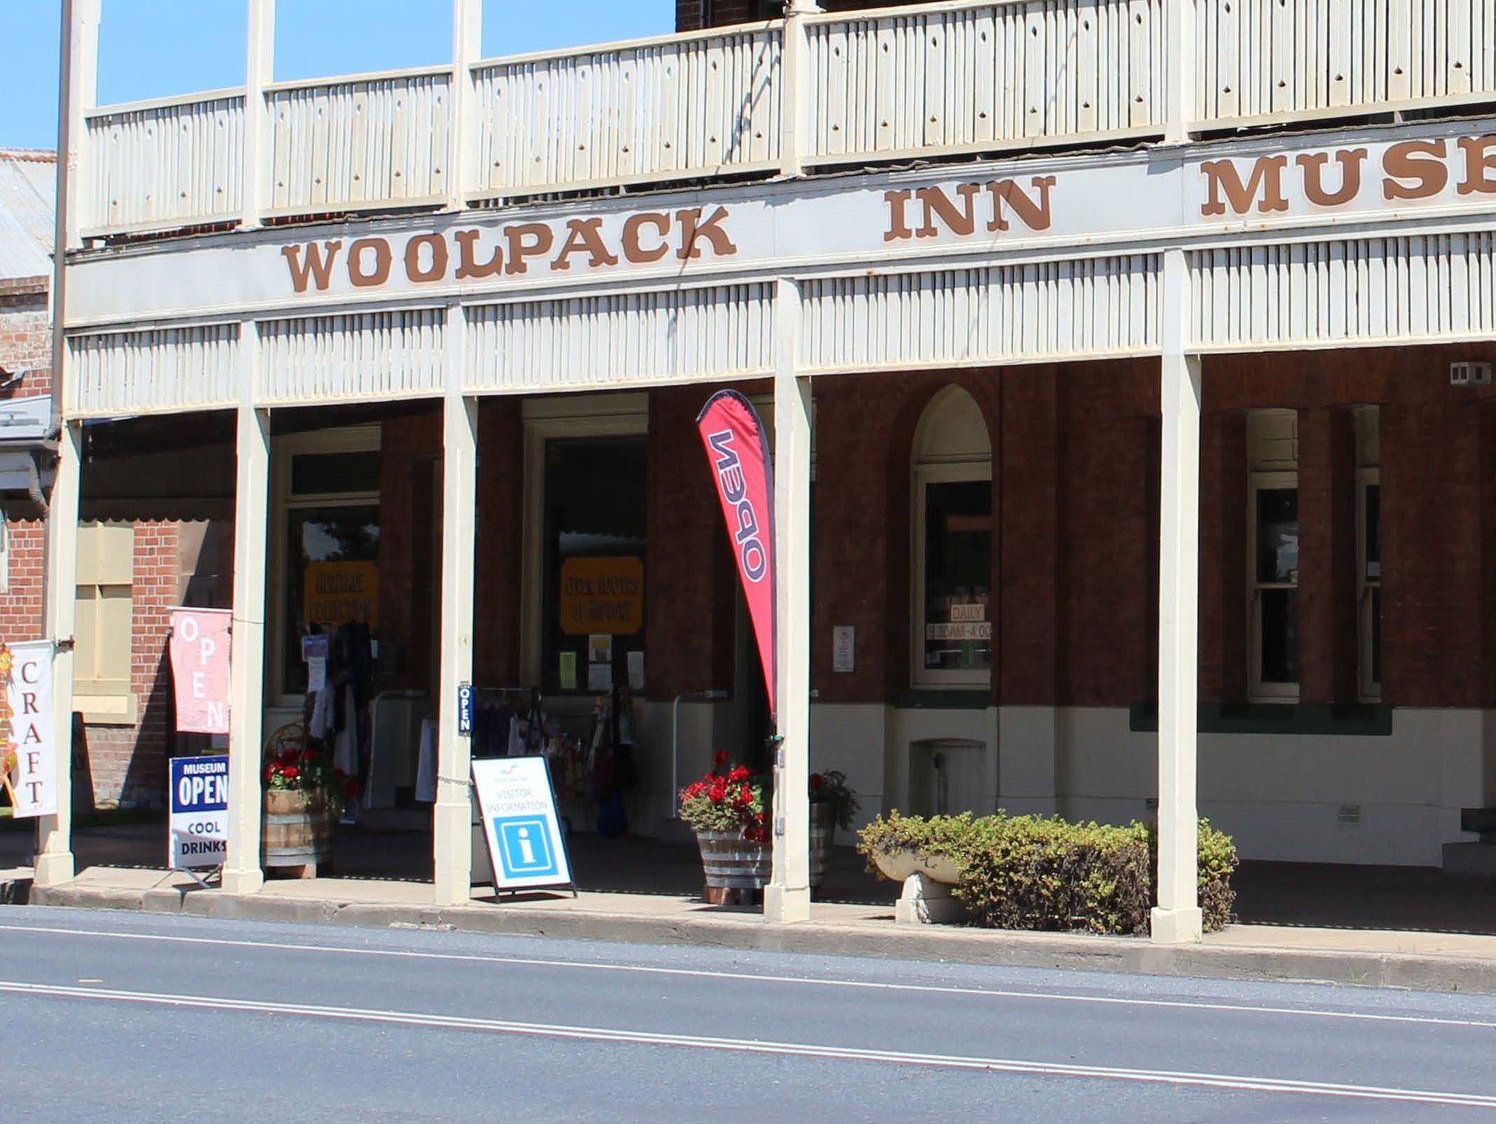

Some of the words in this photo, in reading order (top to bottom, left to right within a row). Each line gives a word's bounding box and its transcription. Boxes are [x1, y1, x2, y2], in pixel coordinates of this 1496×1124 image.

[281, 204, 738, 294] WOOLPACK
[883, 175, 1056, 243] INN
[180, 617, 225, 728] OPEN
[460, 688, 471, 731] OPEN
[21, 661, 44, 805] CRAFT
[183, 762, 226, 774] MUSEUM
[179, 775, 228, 806] OPEN
[496, 788, 533, 800] VISITOR
[486, 799, 548, 814] INFORMATION
[188, 822, 221, 835] COOL
[181, 840, 227, 855] DRINKS
